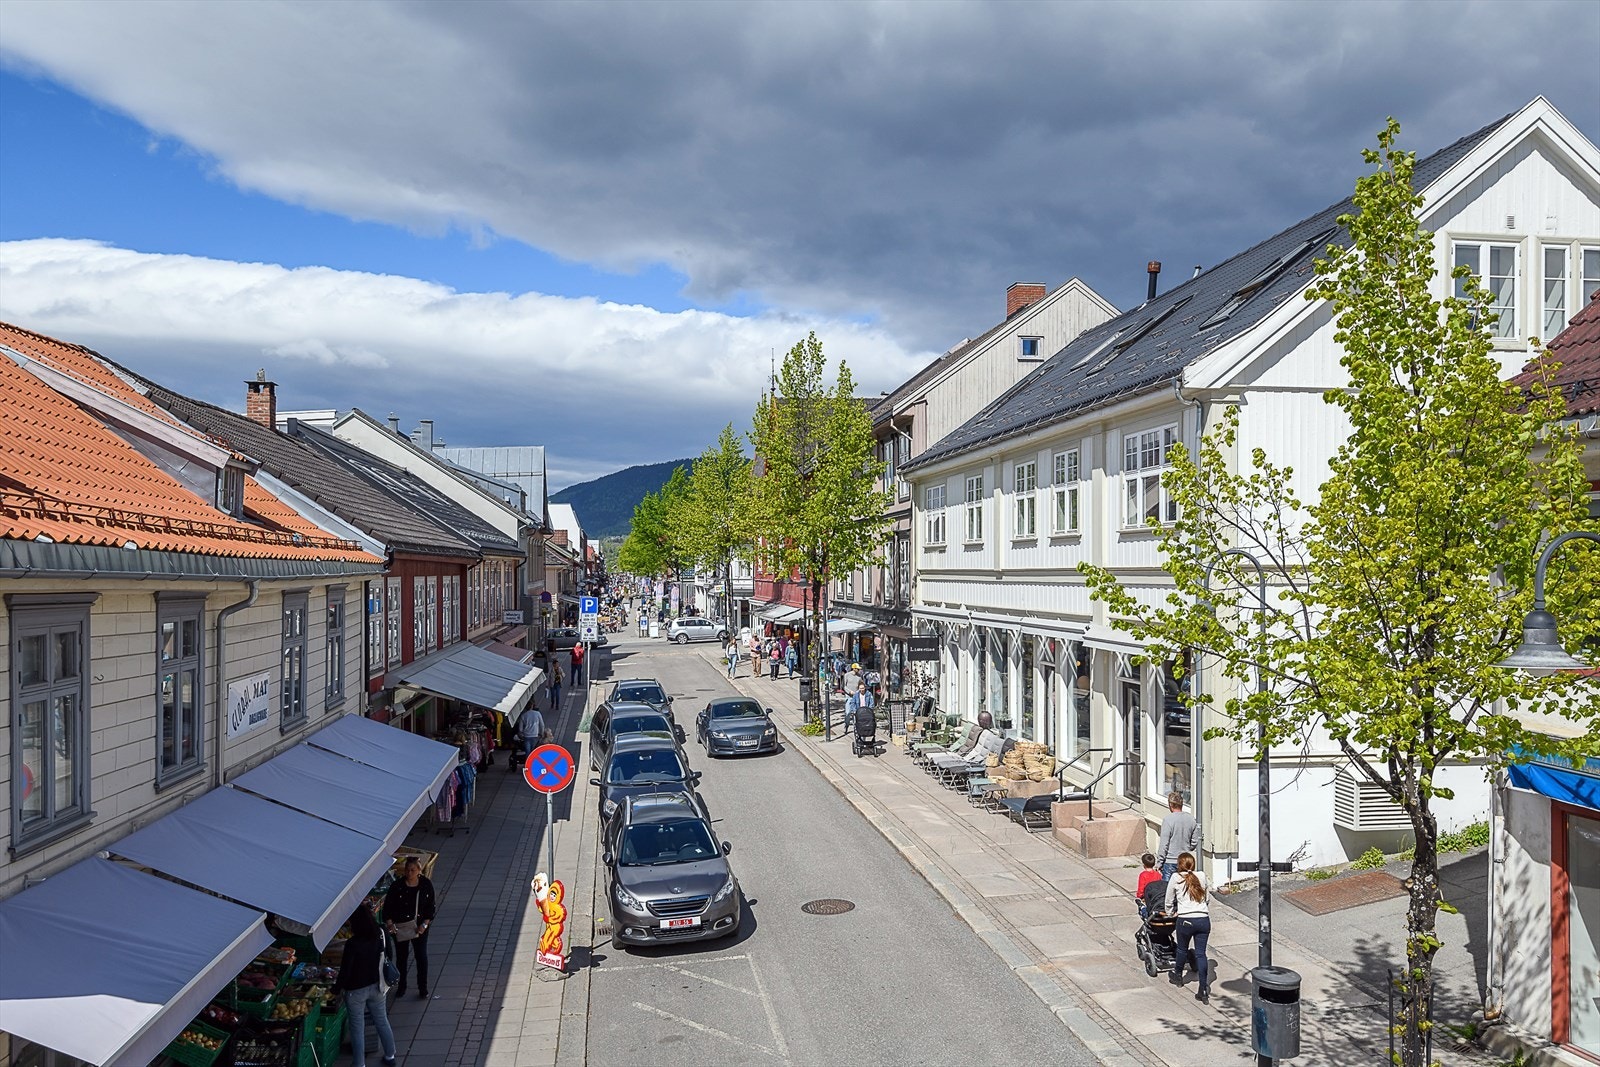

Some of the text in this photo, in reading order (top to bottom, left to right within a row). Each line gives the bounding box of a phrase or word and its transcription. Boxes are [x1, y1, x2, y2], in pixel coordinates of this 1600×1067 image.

[585, 599, 594, 612] P
[232, 679, 268, 732] GLOBAL MAT
